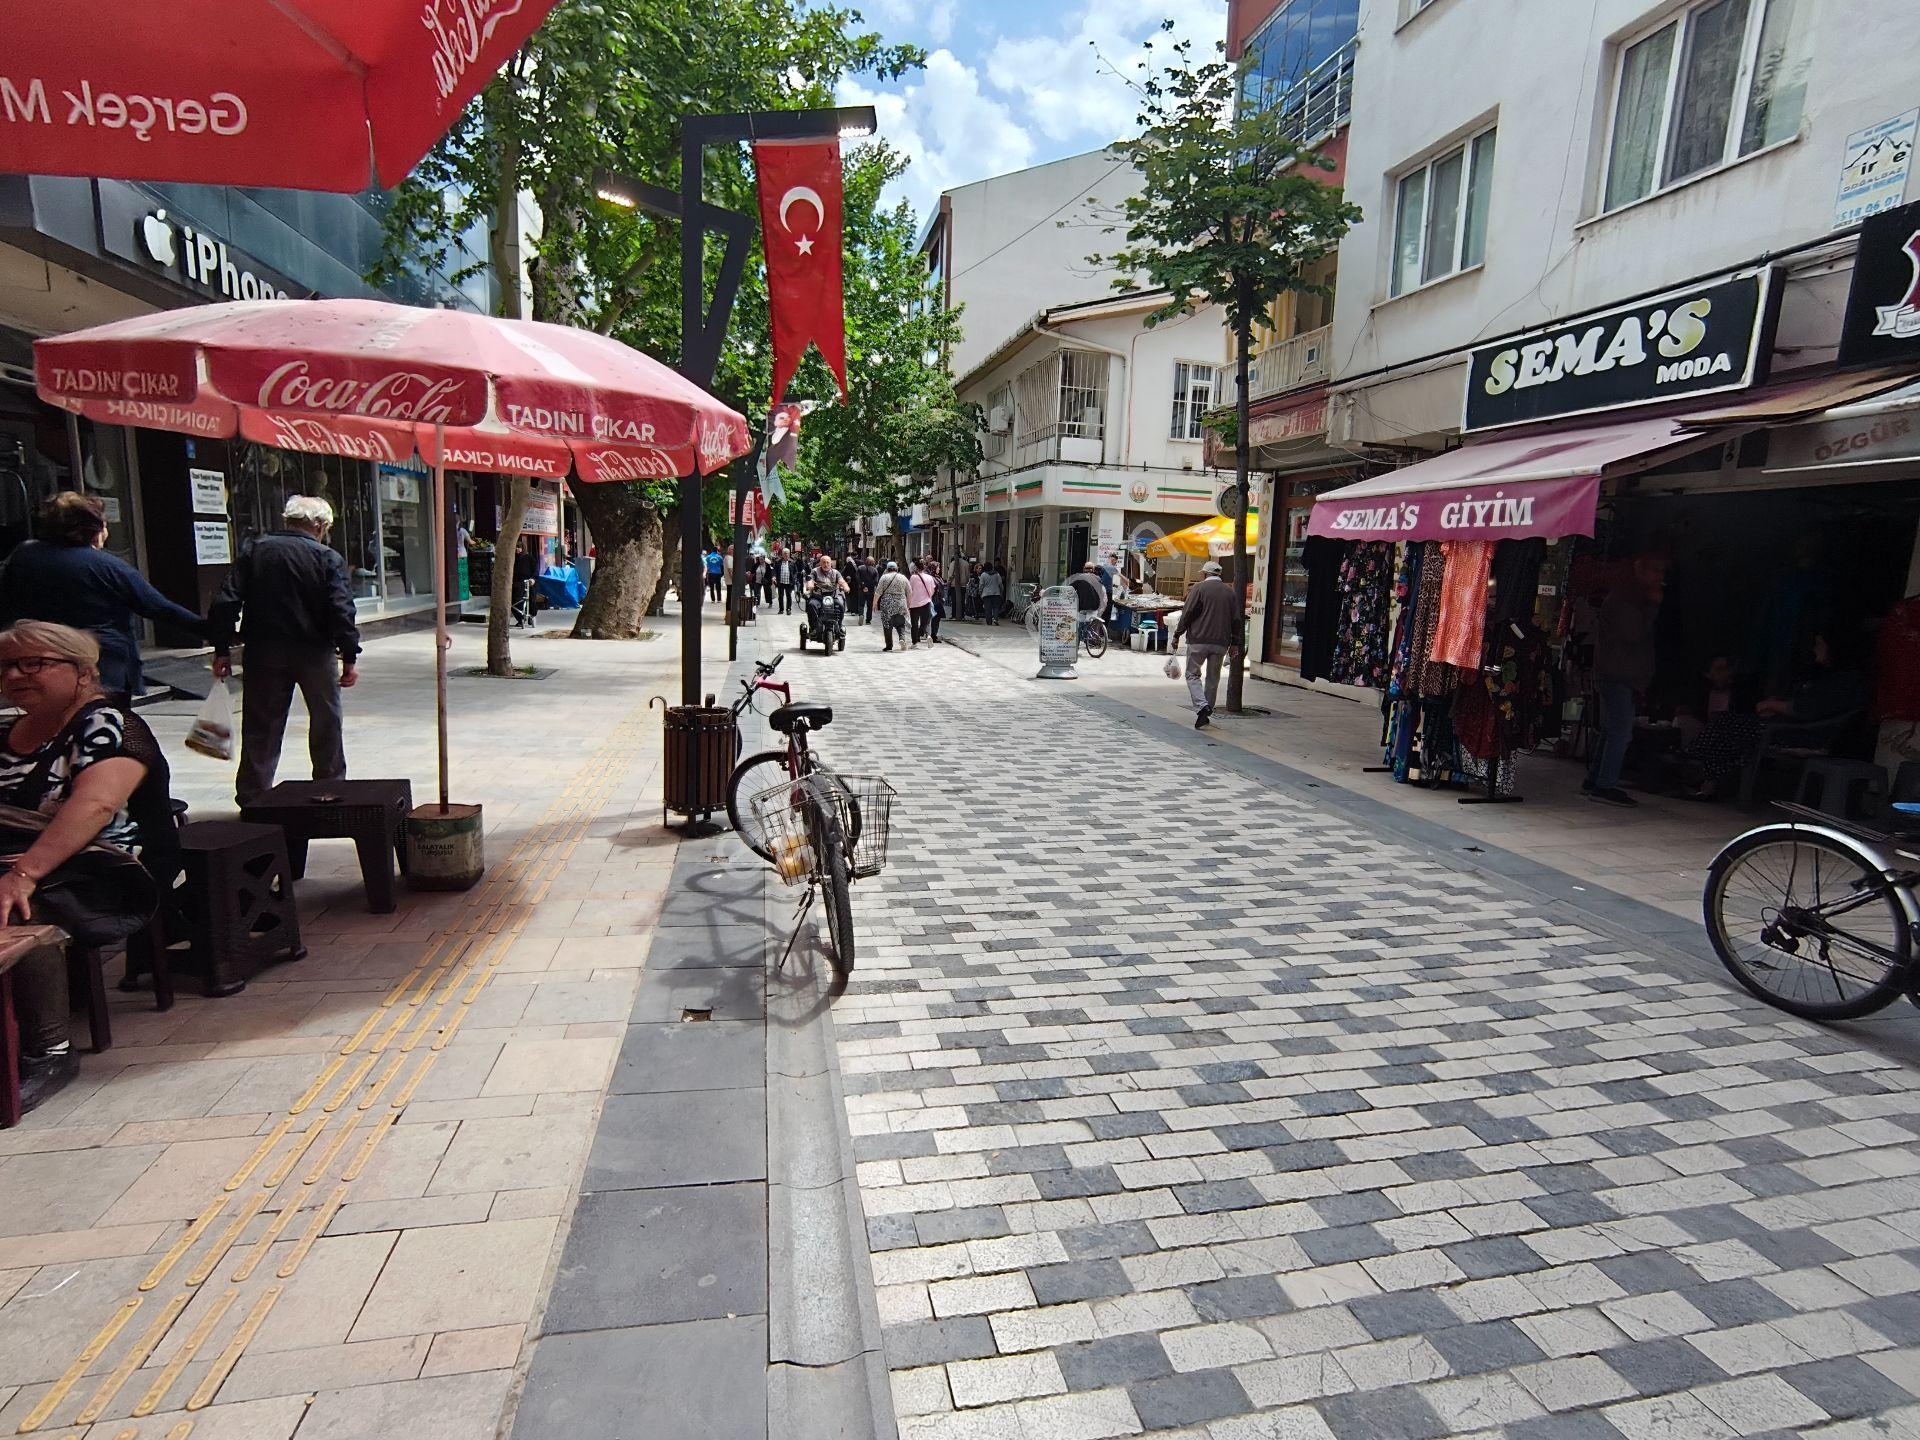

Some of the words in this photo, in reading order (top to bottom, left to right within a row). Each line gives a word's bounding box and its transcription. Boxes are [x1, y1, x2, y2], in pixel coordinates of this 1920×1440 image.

[1485, 298, 1711, 395] SEMA'S
[122, 371, 179, 397] ÇIKAR
[1656, 352, 1731, 384] MODA
[258, 360, 466, 423] Coca-Cola
[507, 404, 584, 433] TADINI
[591, 415, 656, 443] ÇIKAR
[1331, 501, 1420, 531] SEMA'S
[1440, 491, 1535, 530] GİYİM
